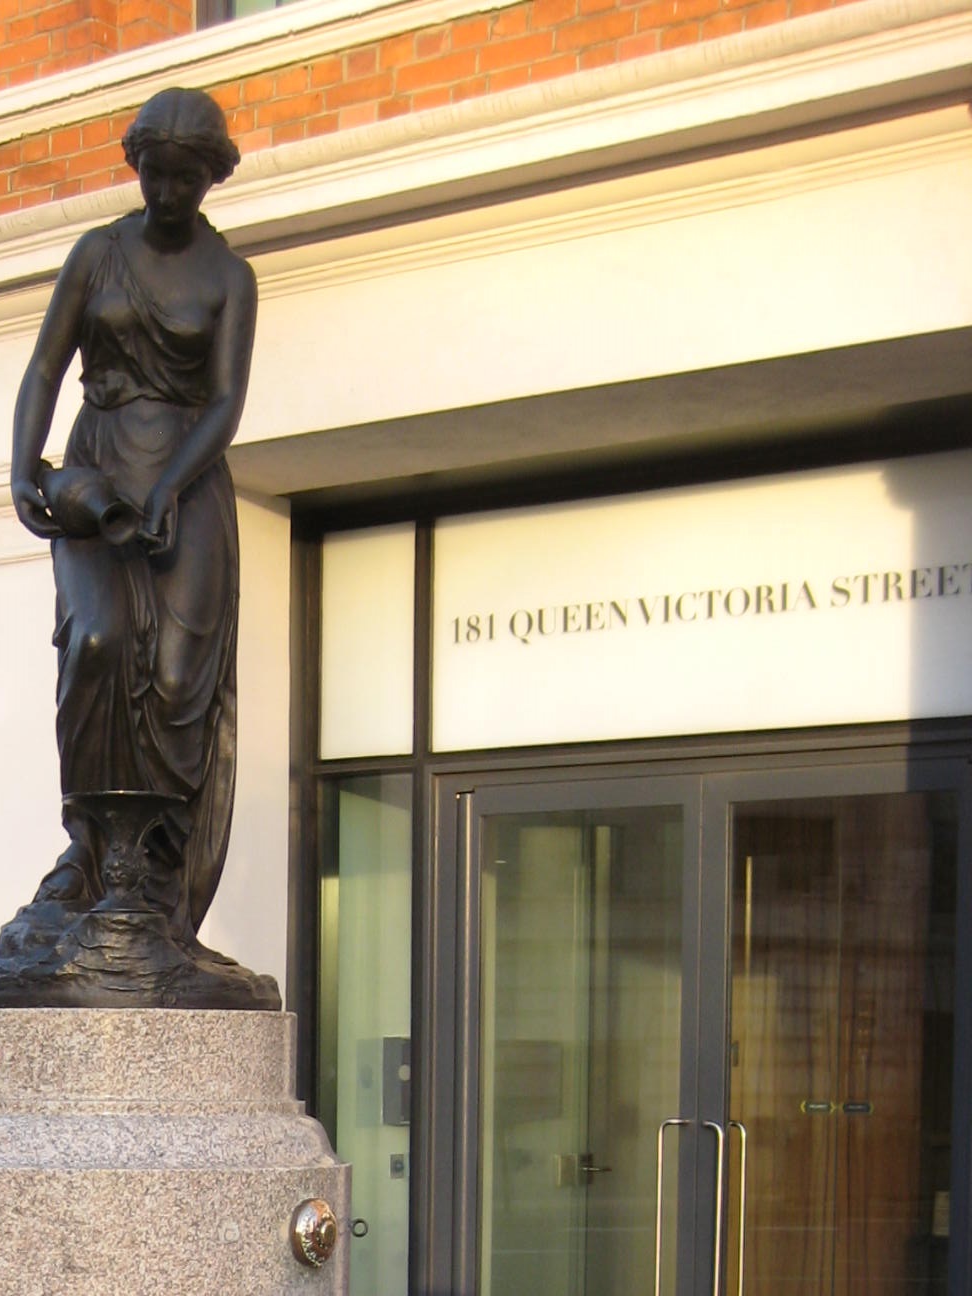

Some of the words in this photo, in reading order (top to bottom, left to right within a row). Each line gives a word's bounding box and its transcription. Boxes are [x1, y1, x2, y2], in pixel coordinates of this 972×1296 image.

[451, 613, 496, 645] 181
[509, 598, 629, 645] QUEEN
[637, 579, 819, 627] VICTORIA
